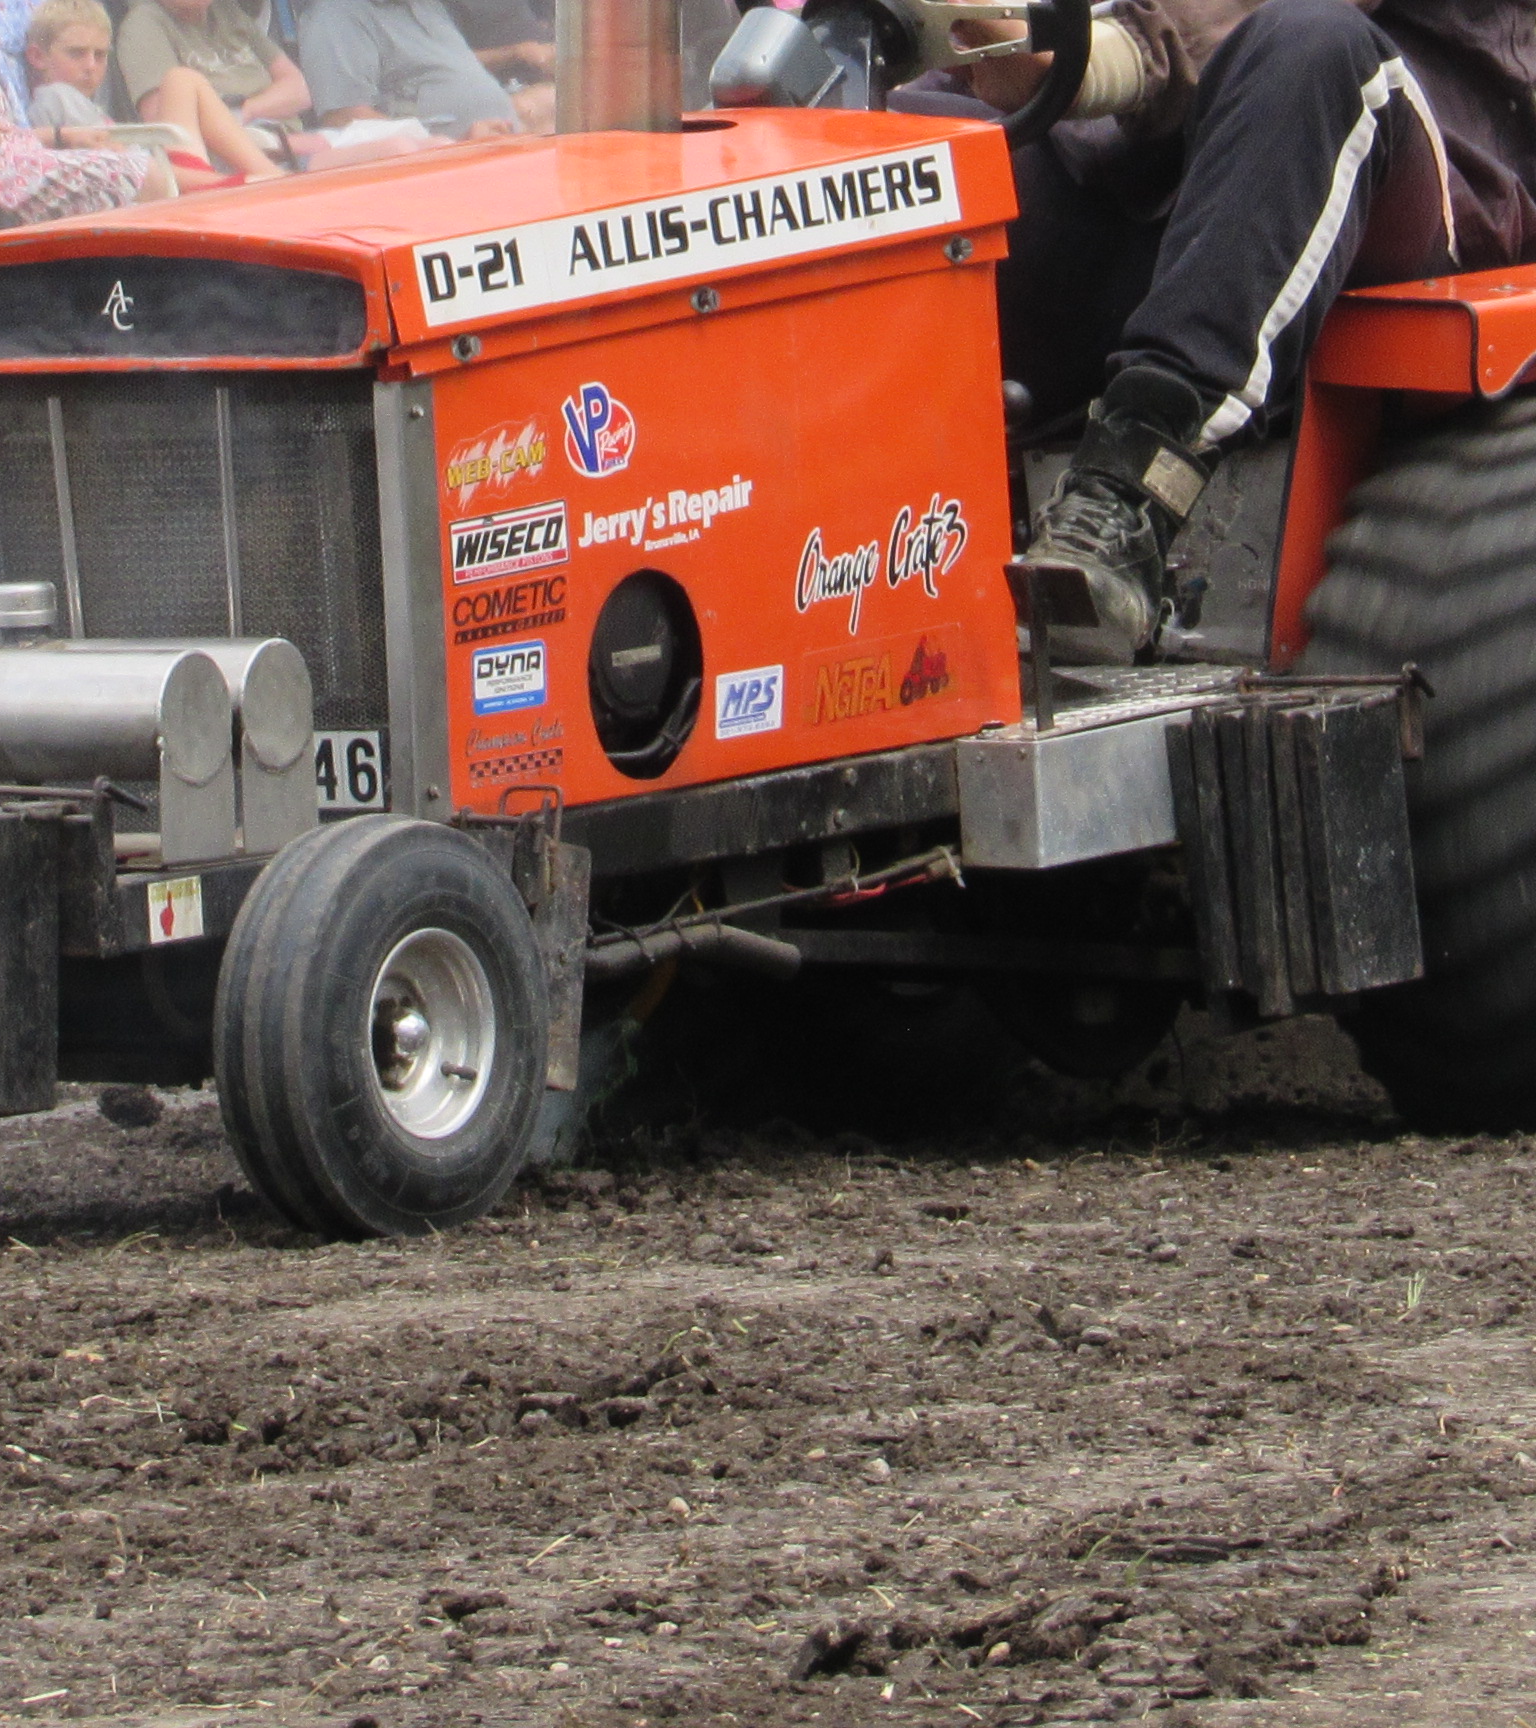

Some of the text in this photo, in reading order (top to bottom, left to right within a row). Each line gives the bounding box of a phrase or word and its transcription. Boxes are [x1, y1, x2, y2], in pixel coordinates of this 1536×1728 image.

[421, 154, 942, 303] D-21 ALLIS-CHALMERS
[563, 383, 611, 474] VP
[447, 441, 546, 489] WEB-CAM
[578, 474, 753, 548] Jerry's Repair
[455, 515, 564, 568] WISECO
[452, 575, 567, 627] COMETIC
[795, 528, 880, 636] Orange
[476, 650, 542, 679] DYNA
[722, 674, 778, 719] MPS
[315, 737, 378, 803] 46
